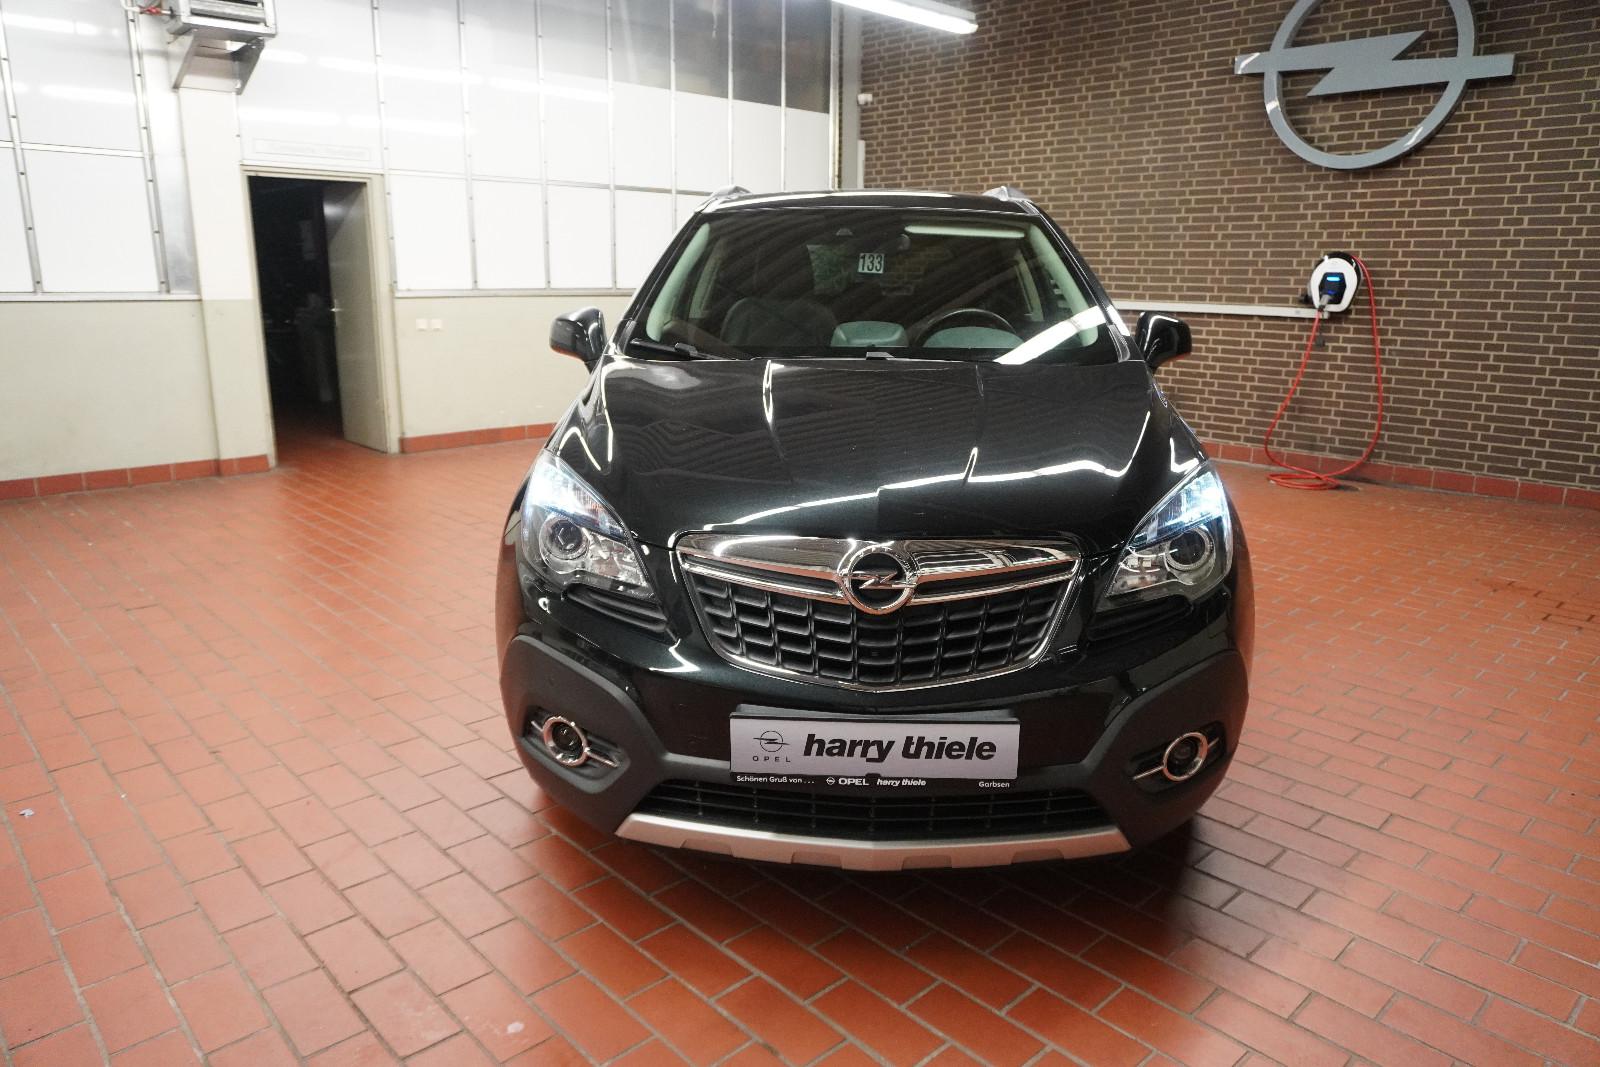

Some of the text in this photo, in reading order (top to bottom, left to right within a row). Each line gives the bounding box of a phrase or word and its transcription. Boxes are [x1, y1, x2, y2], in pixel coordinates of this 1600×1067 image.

[860, 253, 883, 272] 133
[803, 733, 997, 763] harry thiele
[752, 755, 791, 763] OPEL
[736, 775, 768, 783] Schönen
[769, 776, 788, 784] Gruß
[838, 778, 870, 786] OPEL
[876, 778, 900, 787] harry
